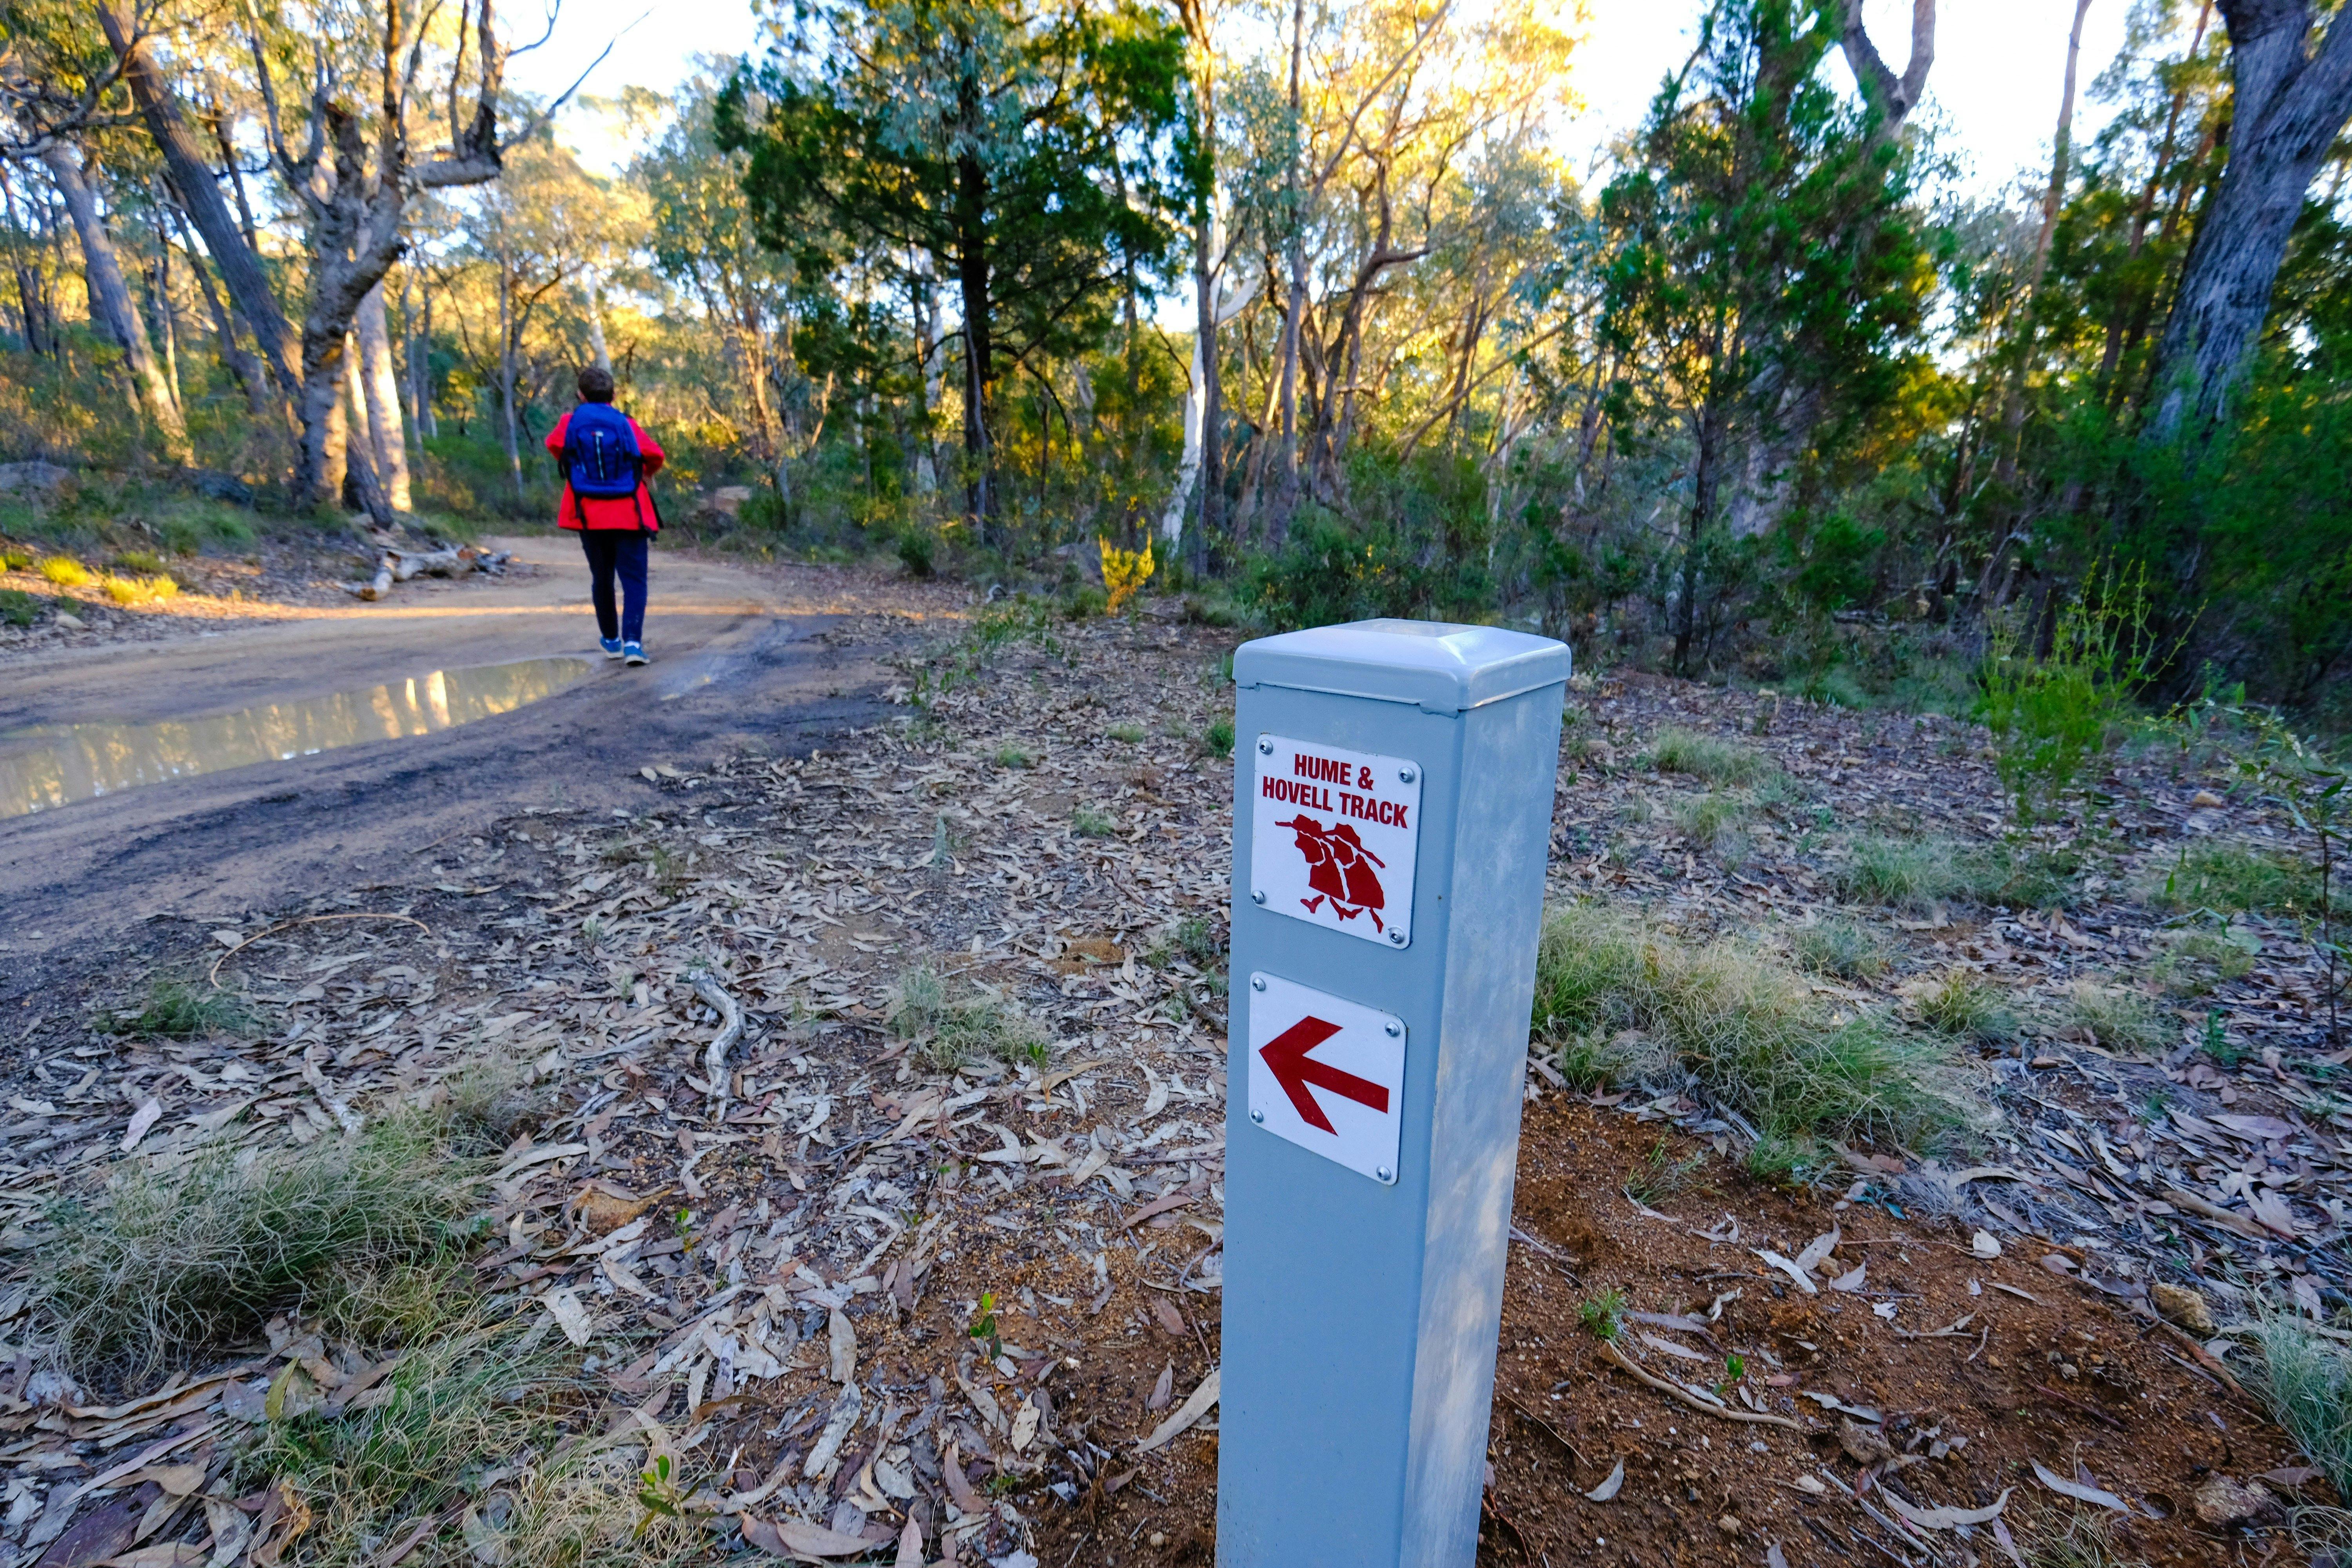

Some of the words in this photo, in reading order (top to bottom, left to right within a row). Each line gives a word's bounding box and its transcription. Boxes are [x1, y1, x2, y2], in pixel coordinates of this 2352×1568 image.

[1295, 754, 1351, 786] HUME
[1358, 767, 1374, 791] &
[1263, 776, 1333, 812] HOVELL
[1339, 792, 1408, 829] TRACK
